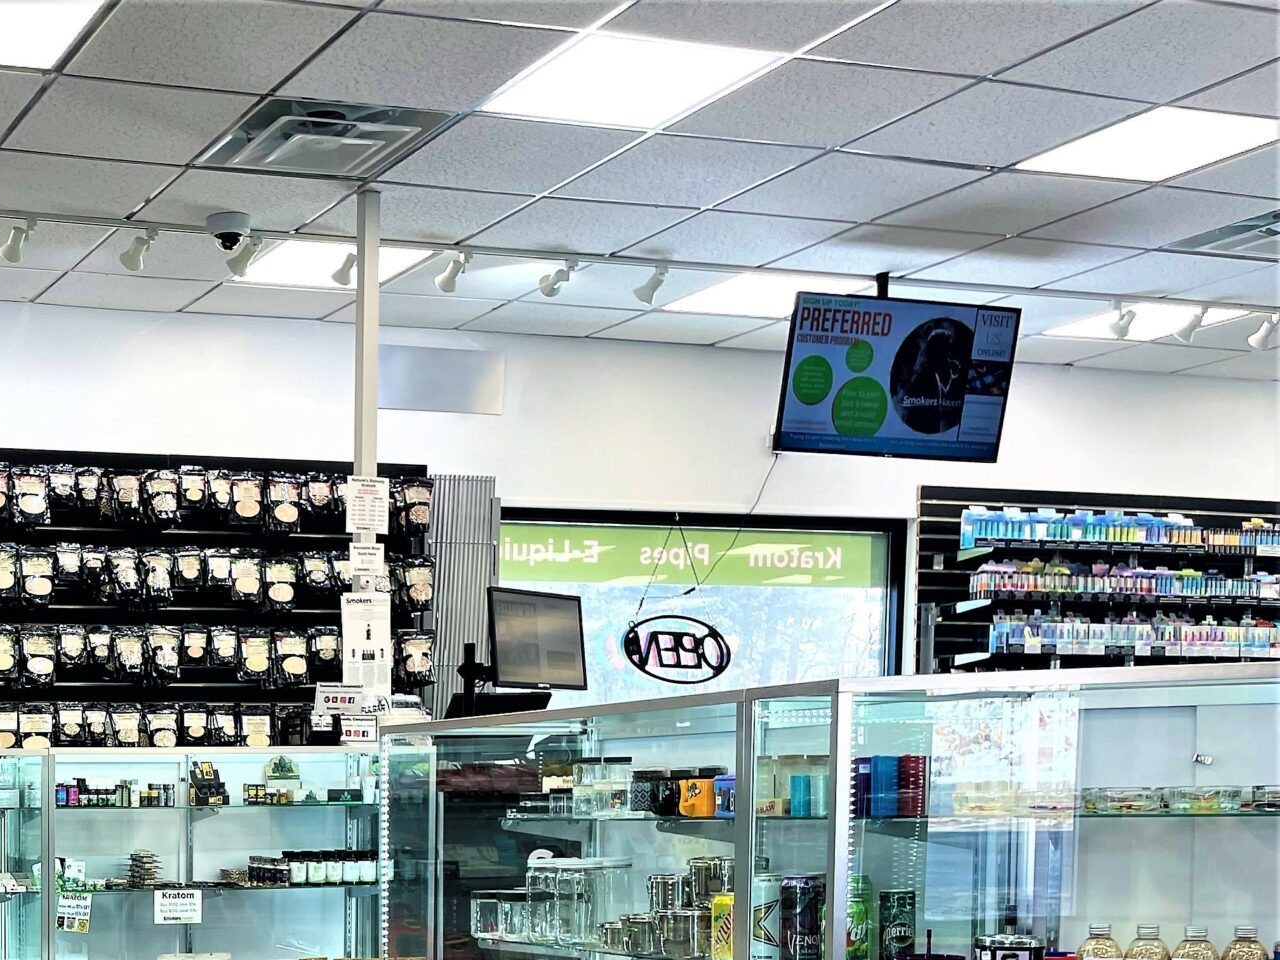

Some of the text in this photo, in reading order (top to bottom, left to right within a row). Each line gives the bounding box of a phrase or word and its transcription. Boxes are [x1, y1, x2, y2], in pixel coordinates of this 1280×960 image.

[799, 306, 893, 337] PREFERRED
[982, 313, 1012, 328] VISIT
[986, 331, 1001, 346] US
[903, 395, 938, 406] Smokers
[759, 803, 775, 814] RAW
[162, 891, 195, 900] Kratom
[787, 929, 819, 955] VENO
